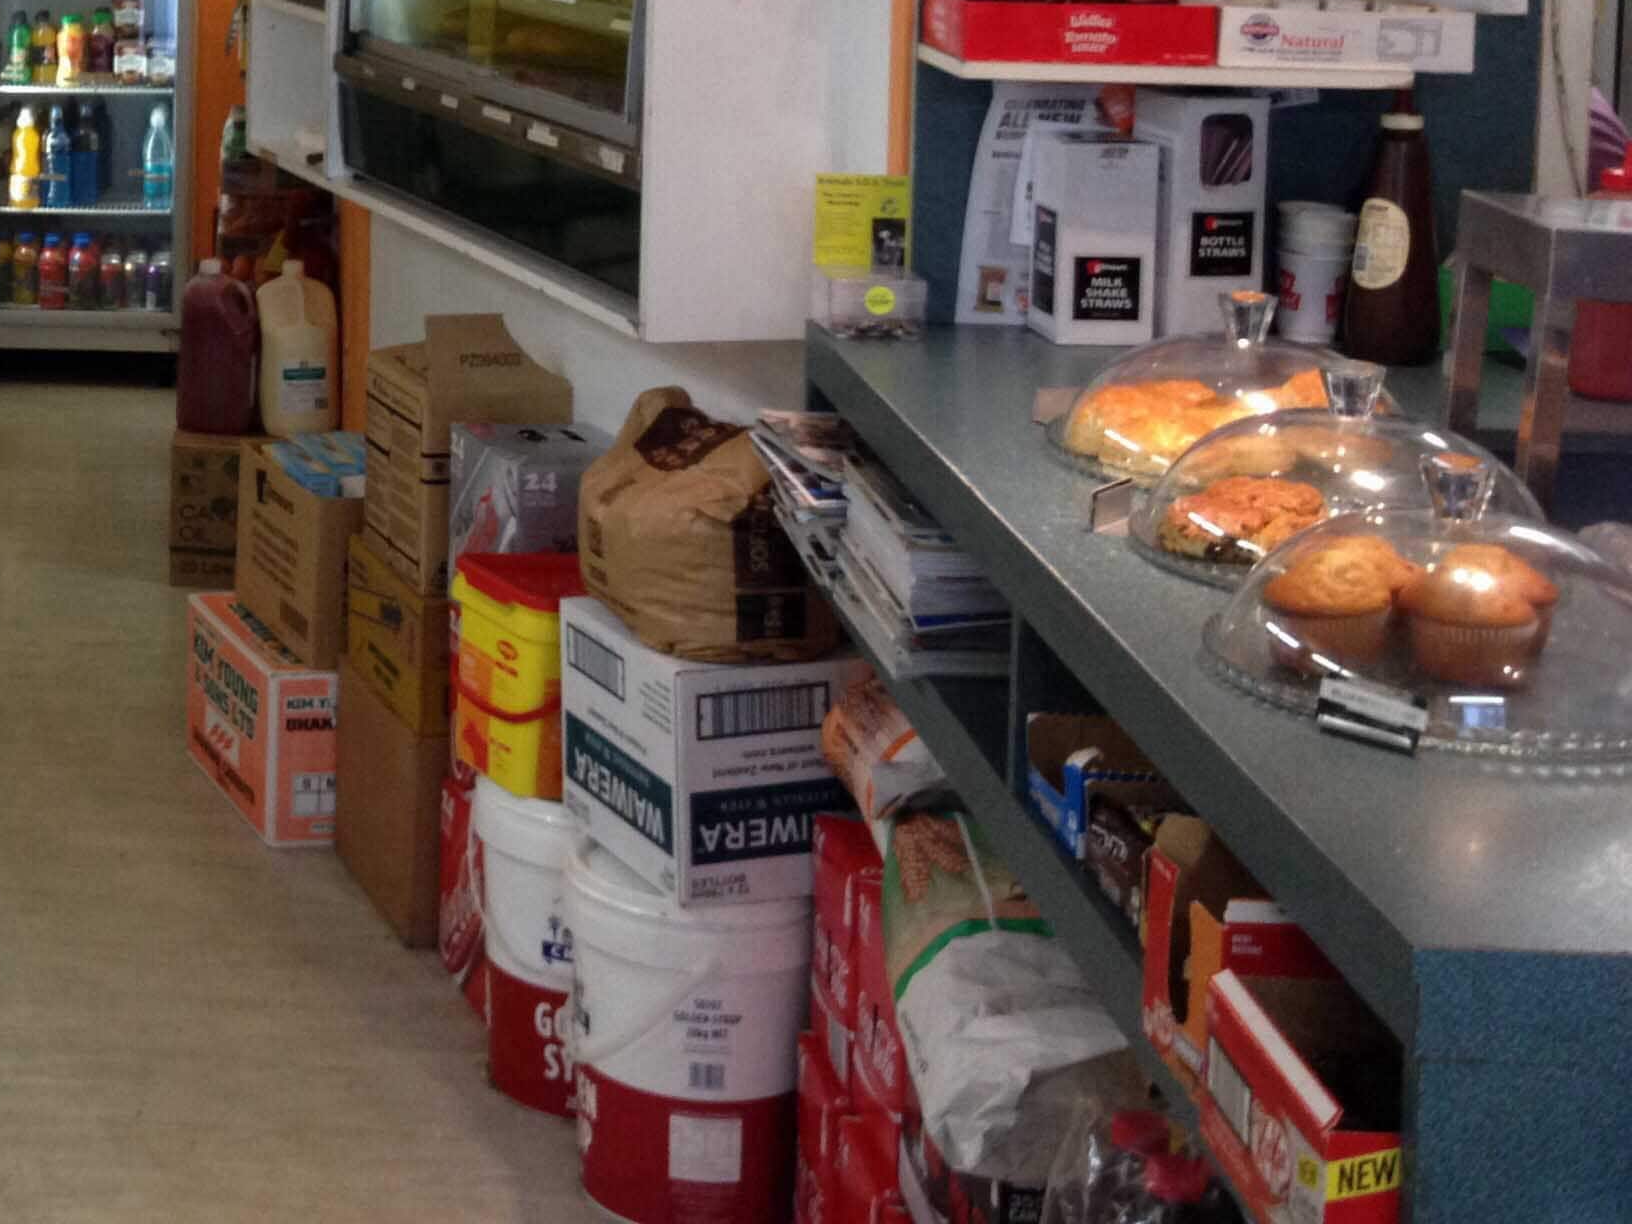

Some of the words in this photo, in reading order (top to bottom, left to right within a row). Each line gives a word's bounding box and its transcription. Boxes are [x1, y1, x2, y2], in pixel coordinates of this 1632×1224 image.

[1280, 33, 1345, 49] Natural
[998, 112, 1030, 129] ALL
[1200, 236, 1245, 247] BOTTLE
[1198, 247, 1247, 258] STRAWS
[1090, 277, 1123, 288] MILK
[1085, 287, 1128, 298] SHAKE
[1080, 298, 1133, 310] STRAWS
[523, 473, 558, 491] 24
[218, 657, 259, 715] YOUNG
[286, 697, 315, 710] KIM
[572, 746, 665, 845] WAIWERA
[699, 812, 809, 853] IWERA
[1337, 1154, 1398, 1195] NEW
